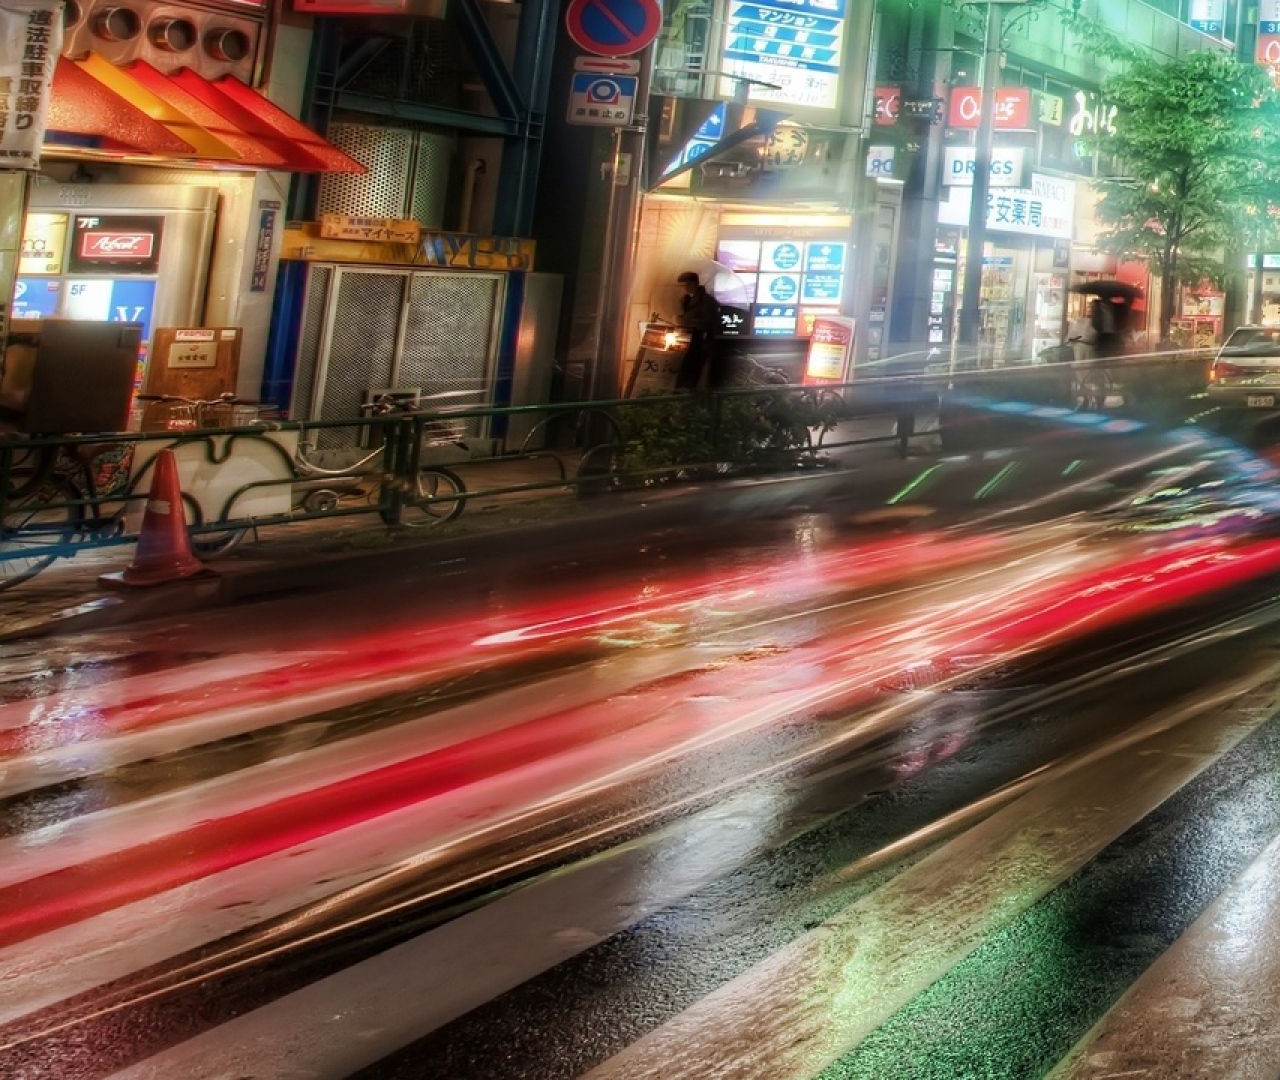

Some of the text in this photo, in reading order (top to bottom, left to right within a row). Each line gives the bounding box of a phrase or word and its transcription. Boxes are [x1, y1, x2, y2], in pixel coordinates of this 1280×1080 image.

[758, 8, 818, 27] マンション
[15, 10, 53, 130] 違法駐車取締り
[953, 159, 1014, 175] DRGS
[77, 217, 99, 229] 7F
[70, 283, 87, 296] 5F
